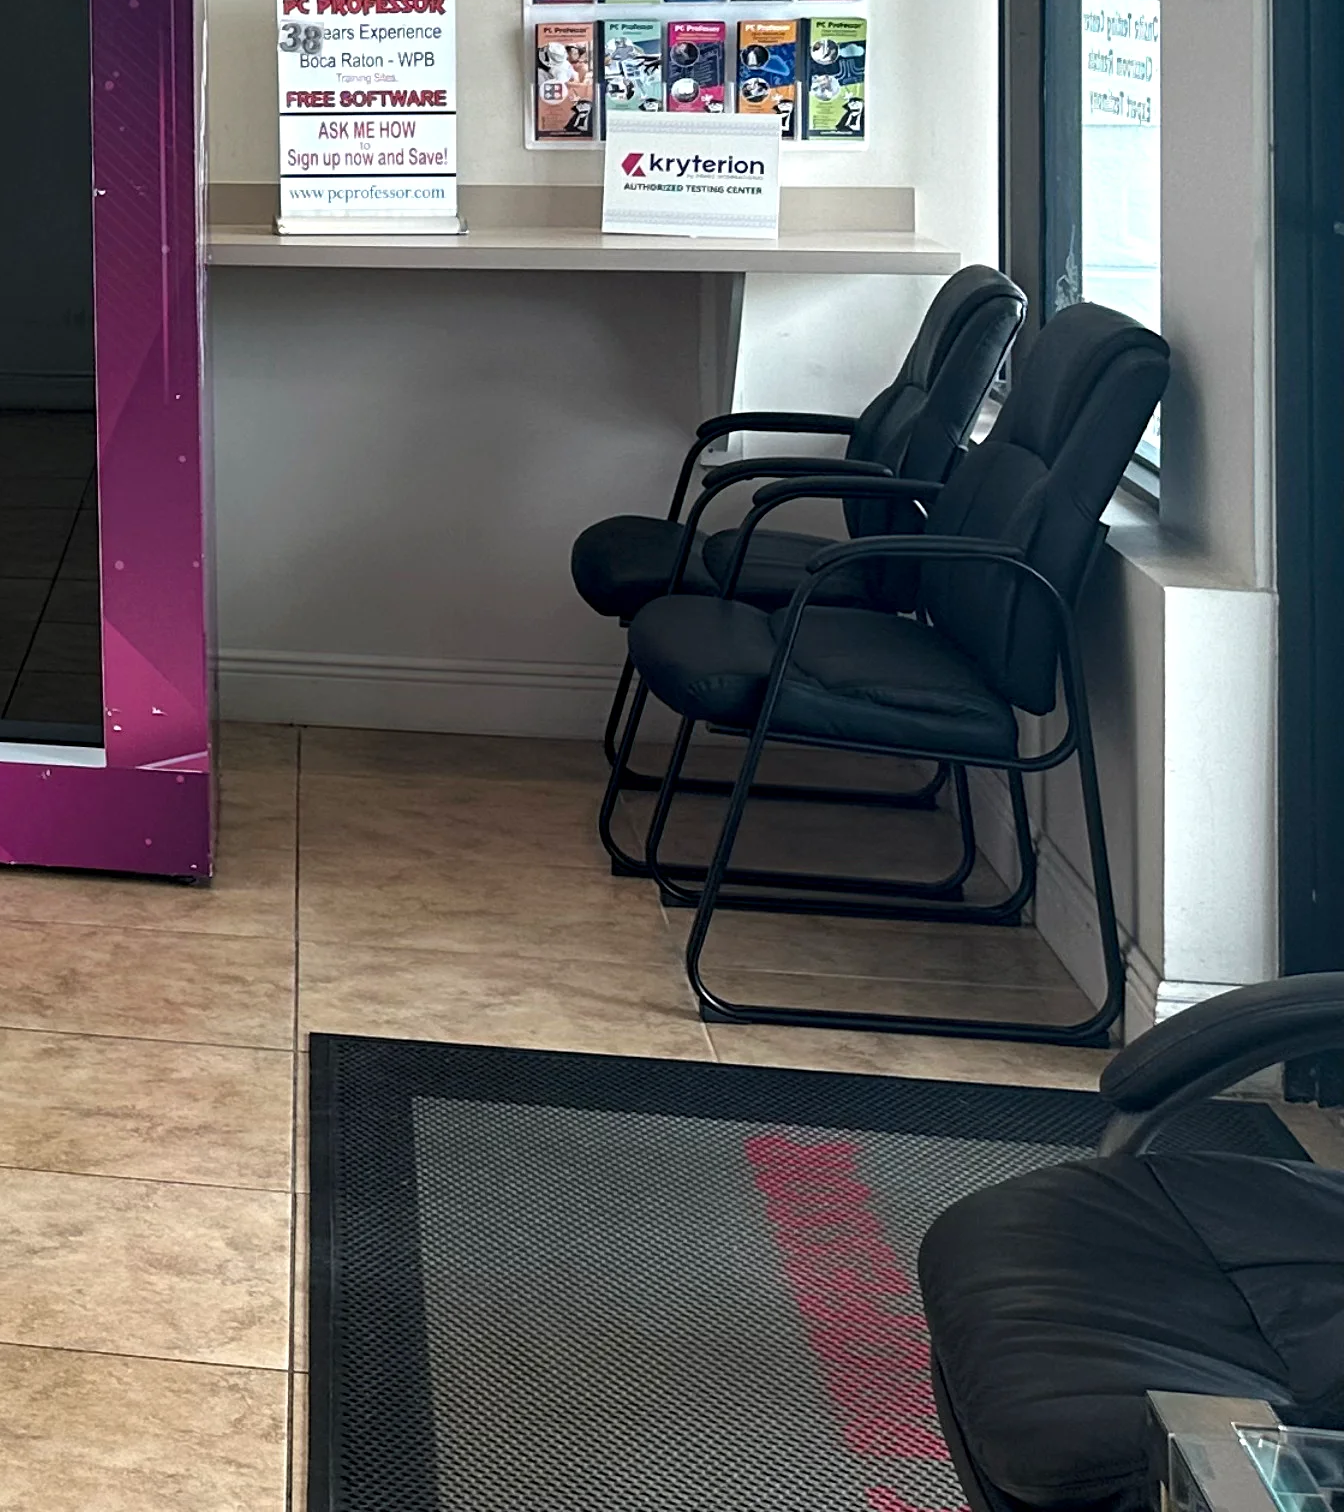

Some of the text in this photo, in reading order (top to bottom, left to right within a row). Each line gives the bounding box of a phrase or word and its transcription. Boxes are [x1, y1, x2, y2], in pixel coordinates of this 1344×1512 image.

[279, 22, 323, 55] 38
[322, 23, 444, 43] ears Experience
[300, 53, 336, 68] Boca
[341, 52, 384, 68] Raton
[398, 51, 435, 67] WPB
[336, 72, 372, 85] Training
[286, 90, 448, 109] FREE SOFTWARE
[318, 121, 417, 140] ASK ME HOW
[287, 147, 448, 171] Sign up now and Save!
[649, 153, 766, 178] kryterion
[289, 185, 446, 204] www.pcprofessor.com
[623, 182, 763, 195] AUTHORIZED TESTING CENTER
